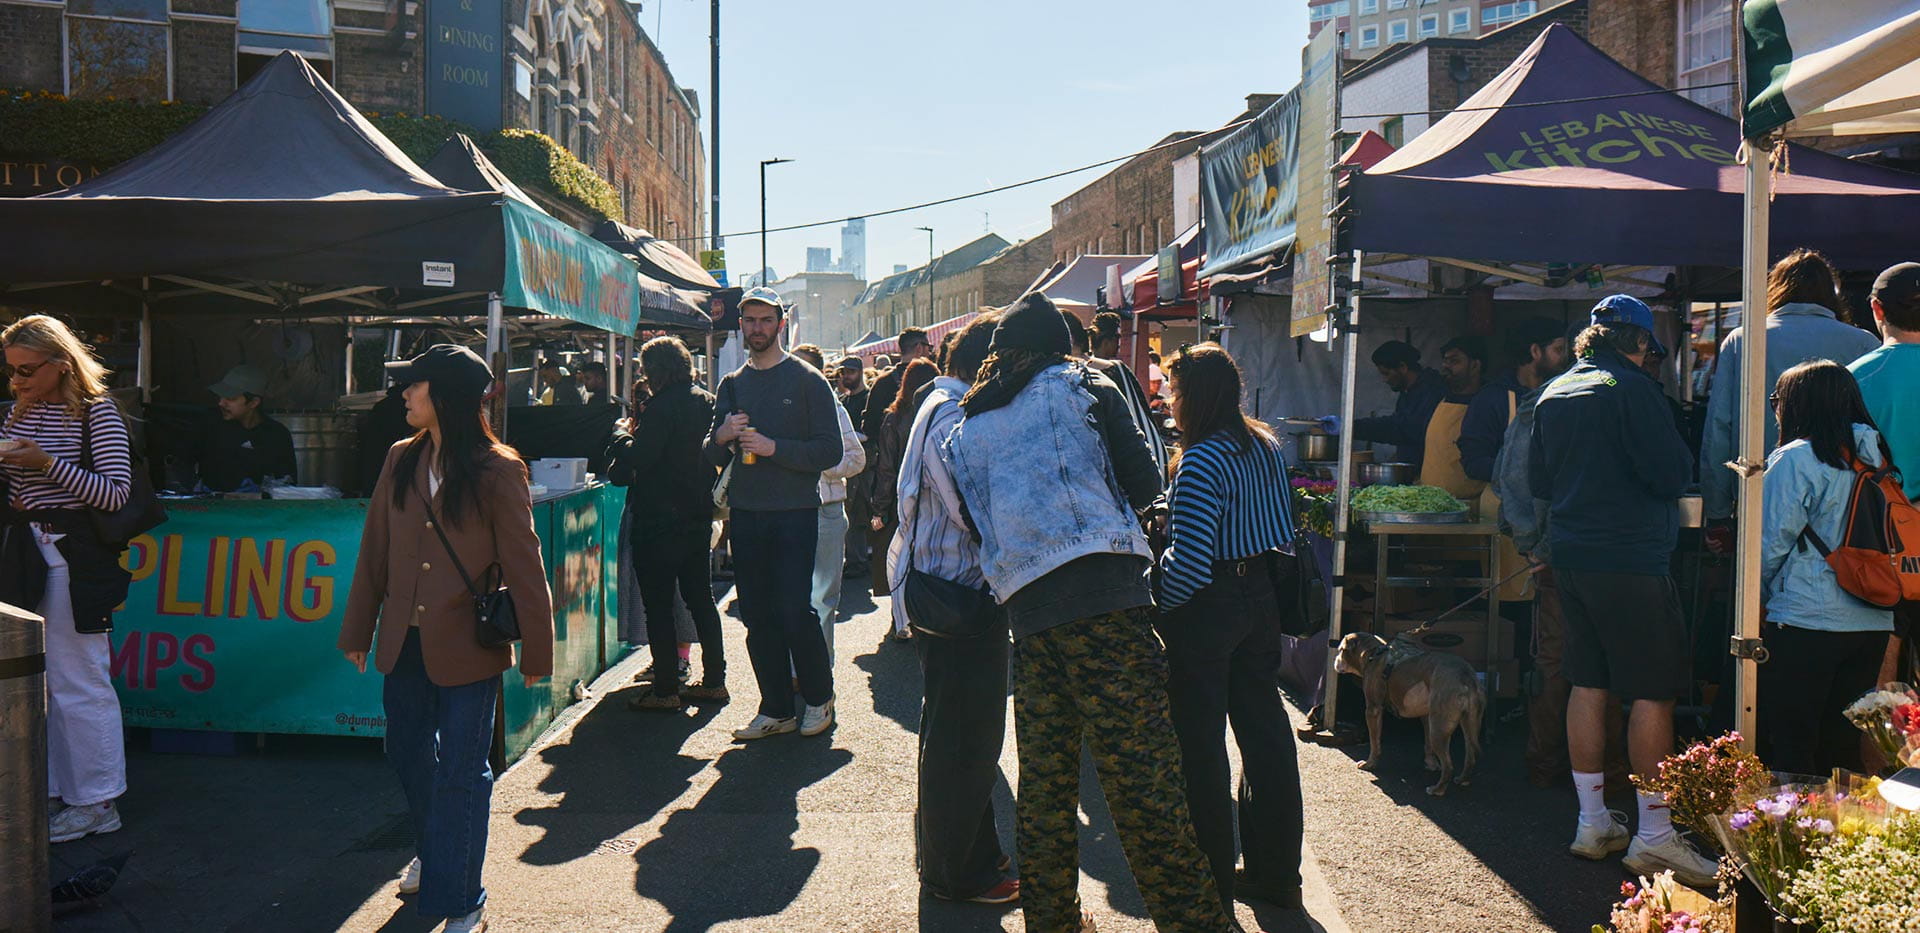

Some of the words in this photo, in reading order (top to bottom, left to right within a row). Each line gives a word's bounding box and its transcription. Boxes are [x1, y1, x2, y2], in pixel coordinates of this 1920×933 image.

[440, 24, 493, 52] DINING
[443, 63, 489, 88] ROOM
[1520, 110, 1718, 148] LEBANESE
[1242, 136, 1286, 179] LEBNESE
[112, 534, 337, 622] PLING
[1901, 555, 1920, 574] NI
[107, 630, 216, 693] MPS
